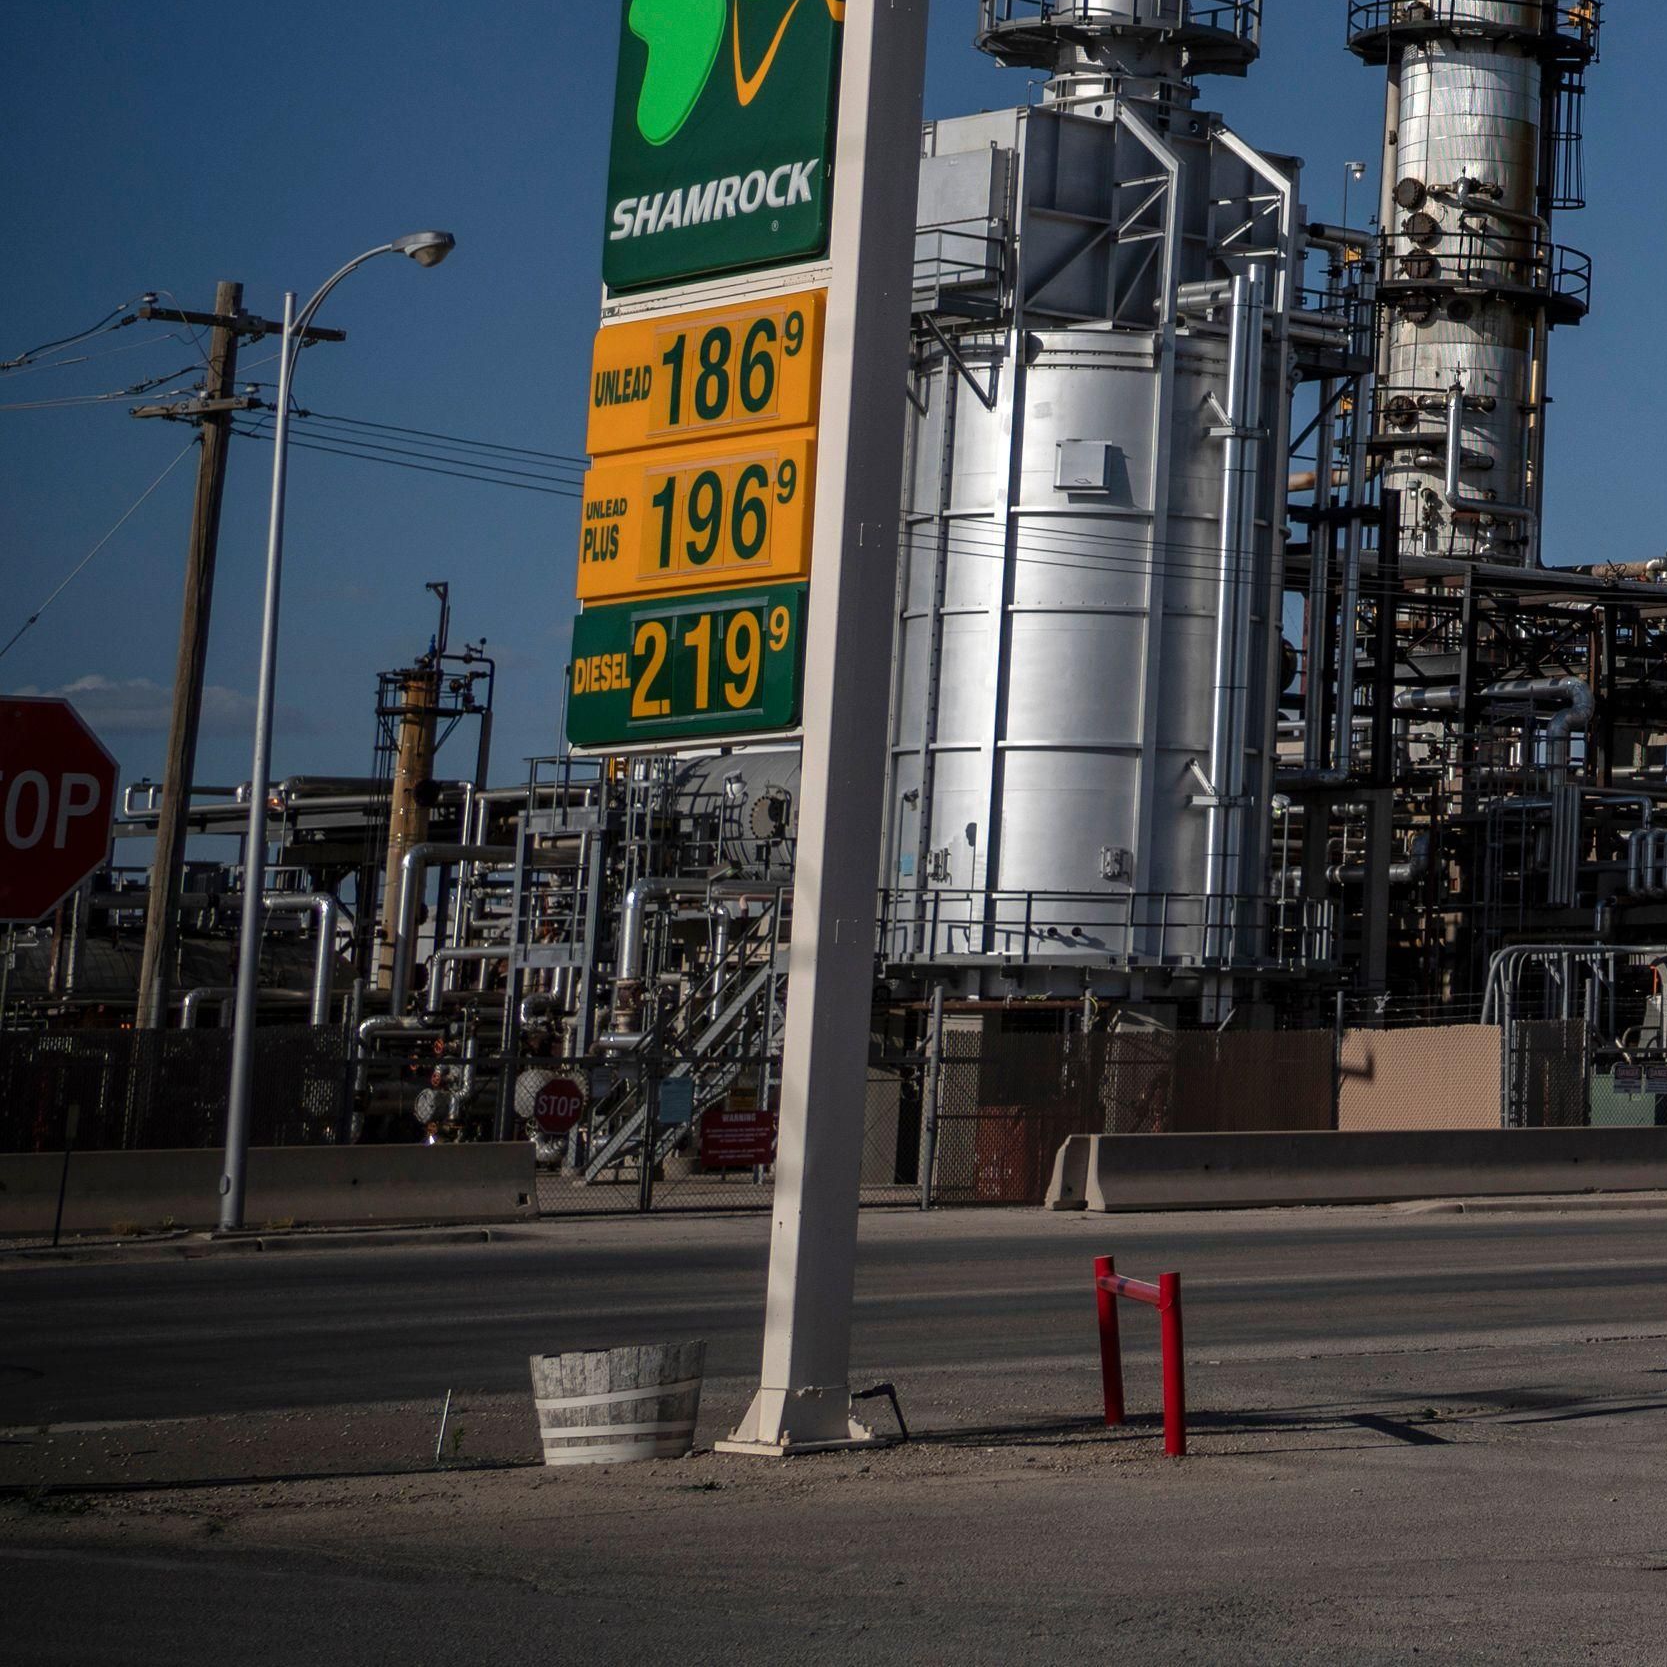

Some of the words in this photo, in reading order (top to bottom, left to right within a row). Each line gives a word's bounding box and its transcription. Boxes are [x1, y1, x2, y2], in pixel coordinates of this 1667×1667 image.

[610, 157, 820, 241] SHAMROCK
[594, 364, 653, 408] UNLEAD
[585, 497, 628, 522] UNLEAD
[582, 525, 620, 564] PLUS
[572, 652, 632, 696] DIESEL
[537, 1094, 582, 1118] STOP
[721, 1112, 757, 1123] WARNING
